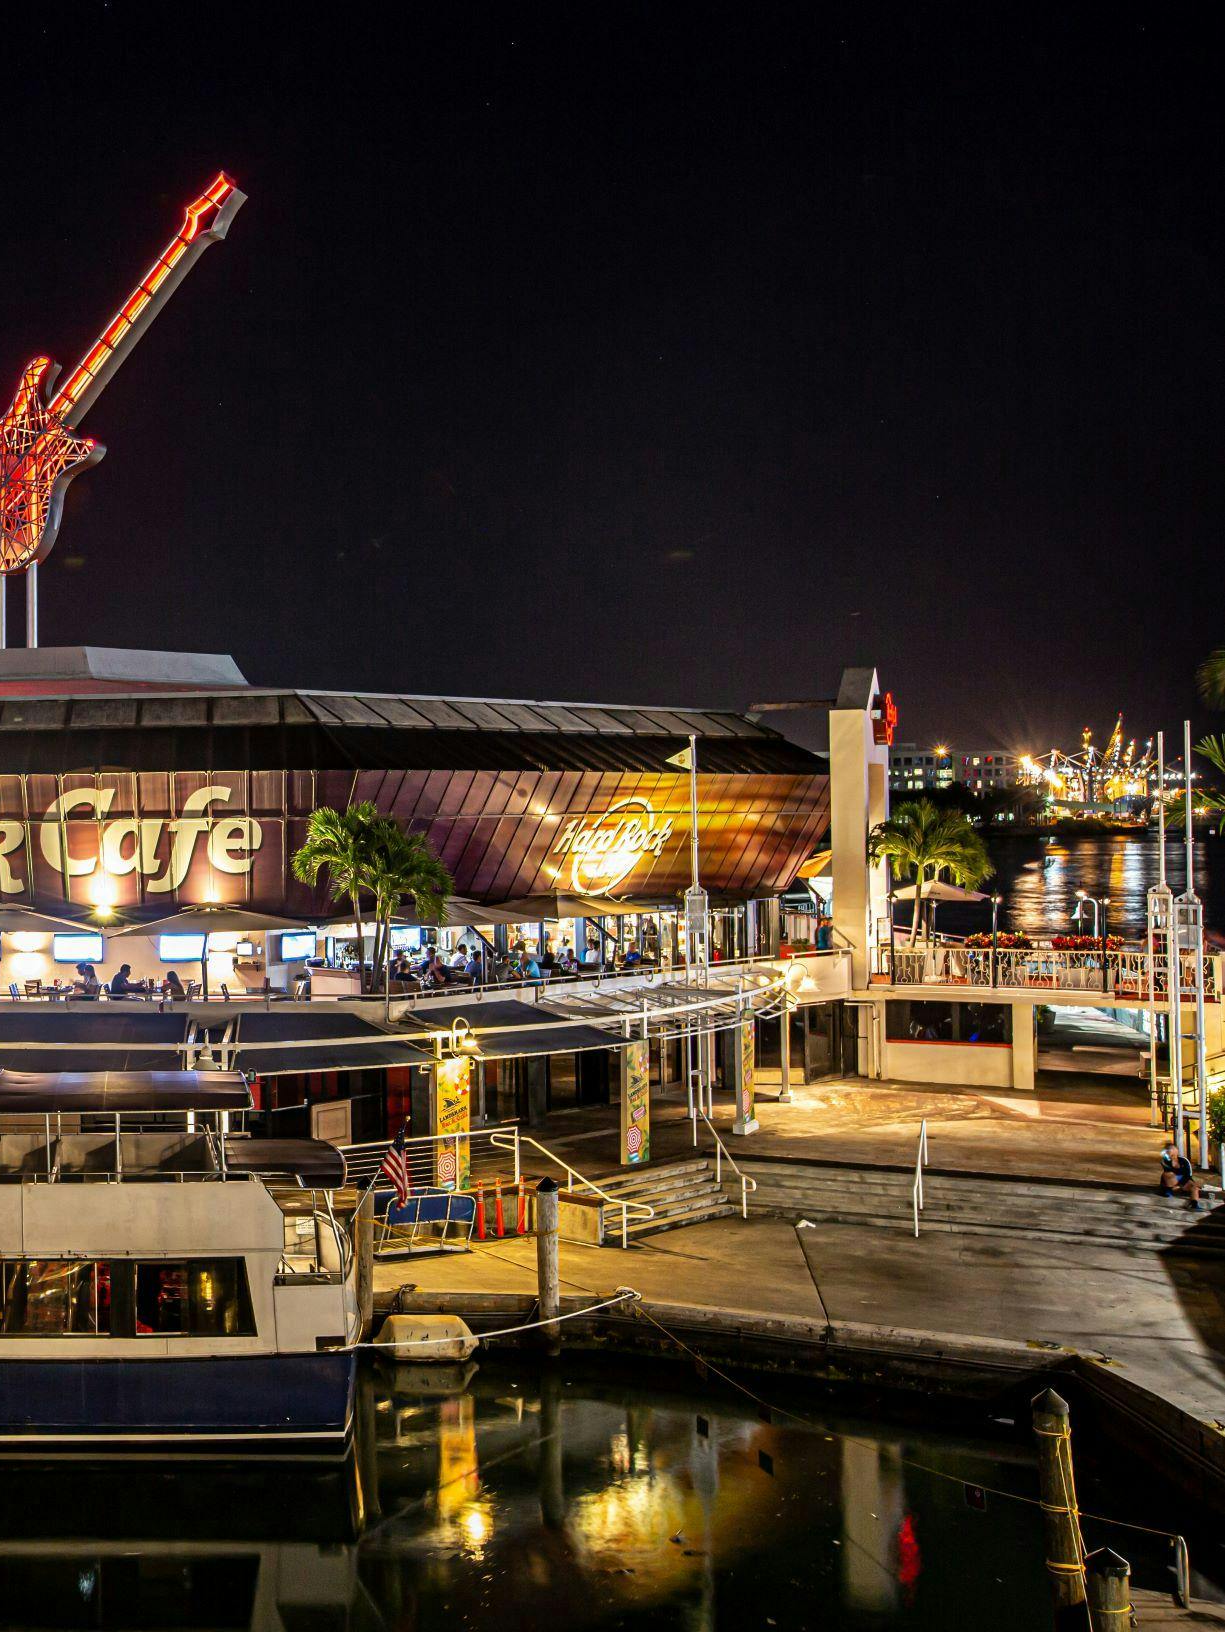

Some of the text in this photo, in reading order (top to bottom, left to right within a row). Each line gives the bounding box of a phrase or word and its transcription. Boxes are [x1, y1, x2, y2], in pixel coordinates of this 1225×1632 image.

[39, 785, 263, 893] Cafe
[552, 817, 674, 858] Hard Rock
